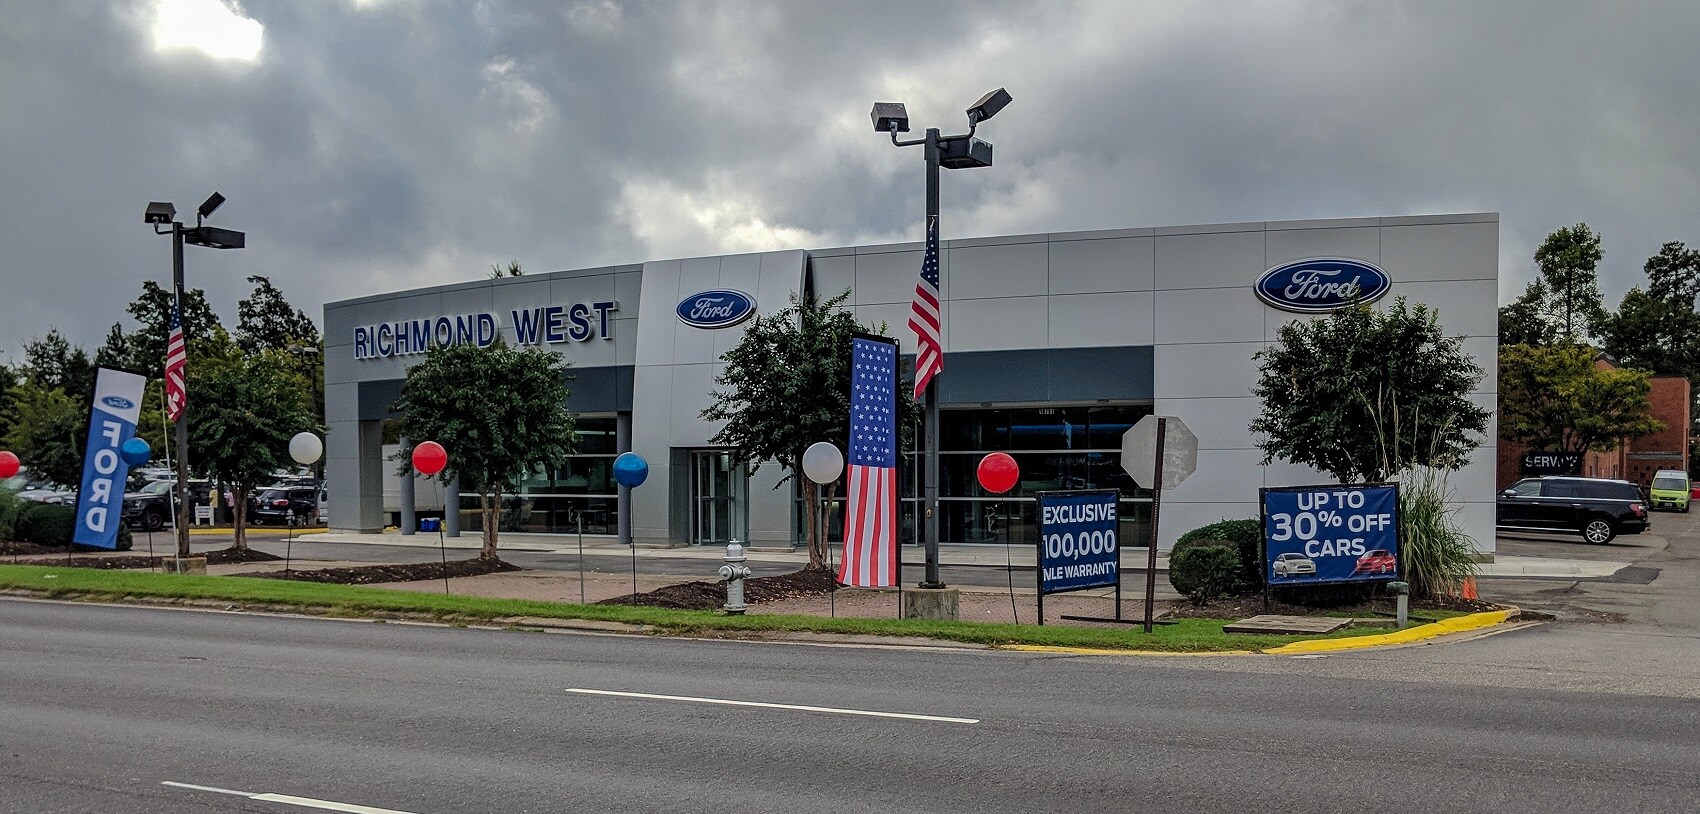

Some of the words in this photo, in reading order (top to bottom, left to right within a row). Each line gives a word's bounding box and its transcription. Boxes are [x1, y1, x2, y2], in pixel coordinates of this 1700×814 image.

[1284, 269, 1361, 299] Ford
[690, 297, 735, 319] Ford
[354, 313, 497, 359] RICHMOND
[511, 300, 615, 345] WEST
[1525, 456, 1577, 467] SERV
[1297, 492, 1329, 511] UP
[1333, 491, 1364, 509] TO
[1043, 503, 1115, 524] EXCLUSIVE
[1271, 511, 1343, 541] 30%
[1347, 513, 1391, 532] OFF
[1043, 530, 1115, 560] 100,000
[1304, 538, 1366, 558] CARS
[1064, 561, 1117, 579] WARRANTY
